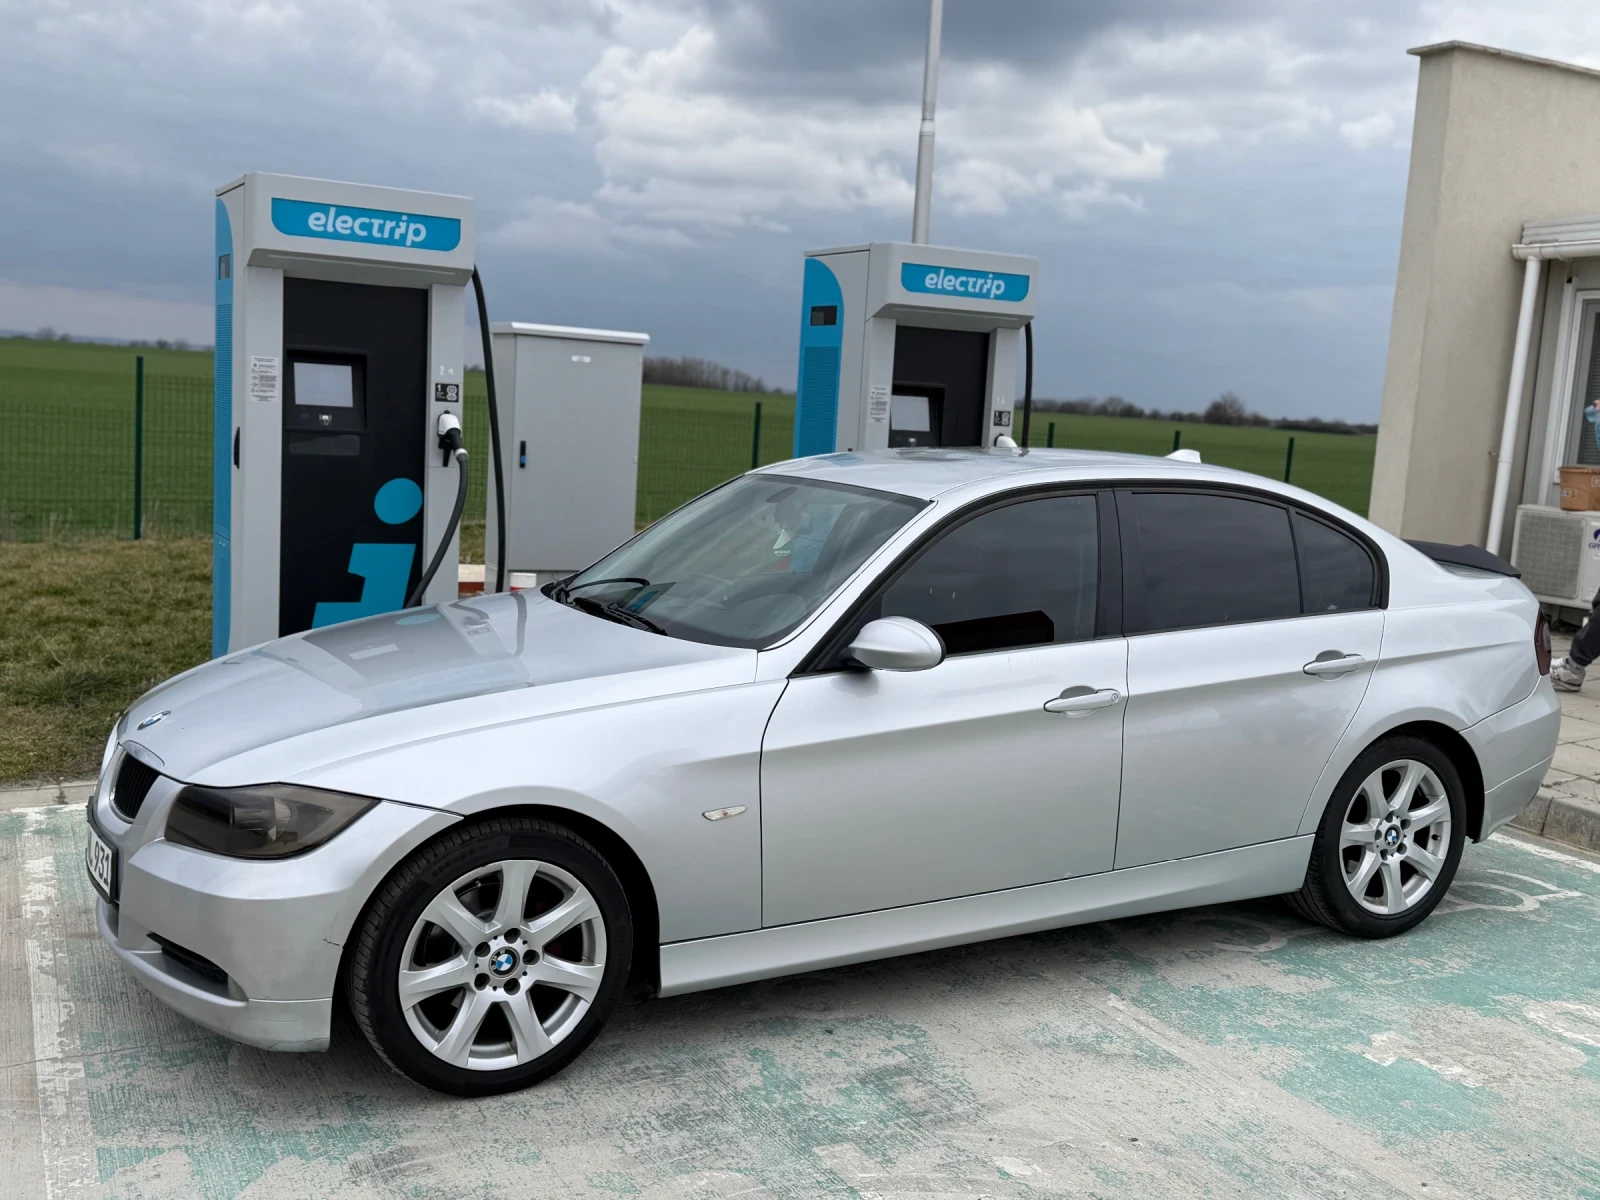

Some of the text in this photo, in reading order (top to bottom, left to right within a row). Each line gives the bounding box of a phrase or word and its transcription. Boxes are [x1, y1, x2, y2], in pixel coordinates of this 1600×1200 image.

[307, 206, 427, 247] electrip
[924, 268, 1006, 299] electrip
[94, 840, 110, 887] 931
